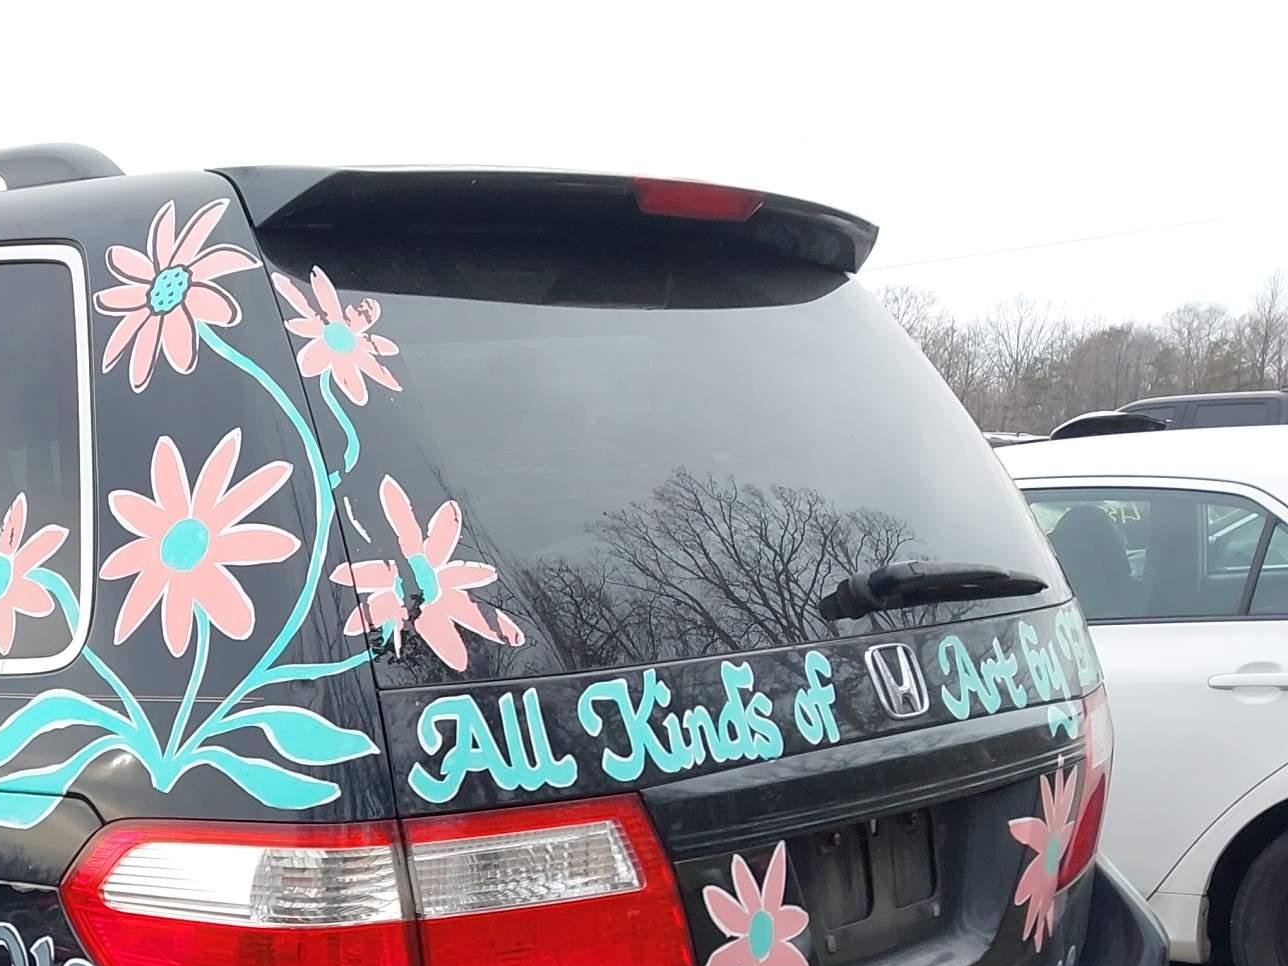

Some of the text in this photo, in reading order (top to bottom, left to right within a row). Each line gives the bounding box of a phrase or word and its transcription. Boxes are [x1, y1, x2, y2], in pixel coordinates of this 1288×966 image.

[407, 687, 578, 804] All
[577, 660, 785, 783] Kinds
[792, 649, 843, 745] of
[938, 635, 1028, 720] Art
